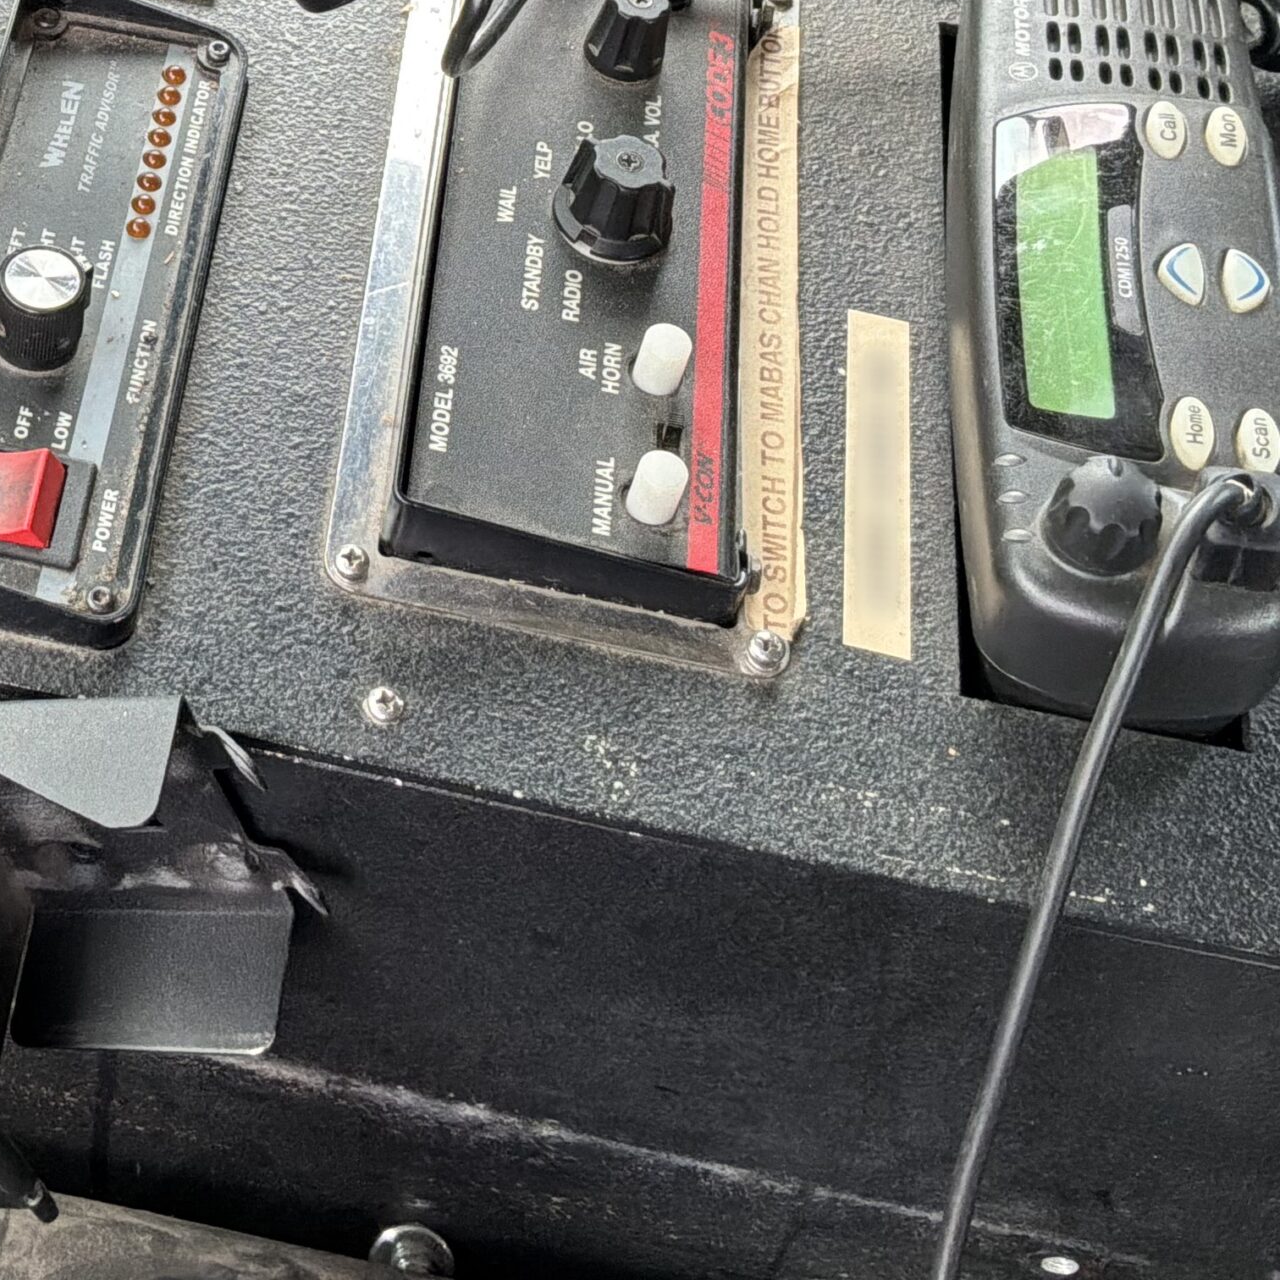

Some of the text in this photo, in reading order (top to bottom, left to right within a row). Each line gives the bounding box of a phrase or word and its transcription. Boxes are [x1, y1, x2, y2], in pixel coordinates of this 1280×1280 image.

[39, 80, 85, 168] WHELEN
[644, 95, 662, 126] VOL
[1160, 113, 1177, 141] Call
[1220, 113, 1238, 147] Mon
[77, 132, 104, 194] TRAFFIC
[164, 79, 211, 237] DIRECTION INDICATOR
[533, 141, 554, 180] YELP
[757, 113, 781, 180] HOME
[496, 185, 517, 223] WAIL
[757, 186, 781, 252] HOLD
[7, 227, 27, 255] EFT
[93, 240, 116, 289] FLASH
[521, 233, 546, 311] STANDBY
[758, 256, 782, 325] CHAN
[1114, 237, 1133, 298] CDM1250
[561, 270, 583, 322] RADIO
[127, 319, 157, 404] FUNCTION
[578, 347, 598, 381] AIR
[600, 342, 623, 395] HORN
[758, 331, 785, 424] MABAS
[14, 405, 34, 440] OFF
[428, 345, 459, 453] MODEL 3692
[1185, 404, 1204, 445] Home
[51, 411, 73, 451] LOW
[760, 429, 785, 467] TO
[1252, 417, 1270, 460] Scan
[92, 487, 119, 553] POWER
[592, 456, 616, 537] MANUAL
[761, 474, 787, 585] SWITCH
[762, 591, 790, 629] TO
